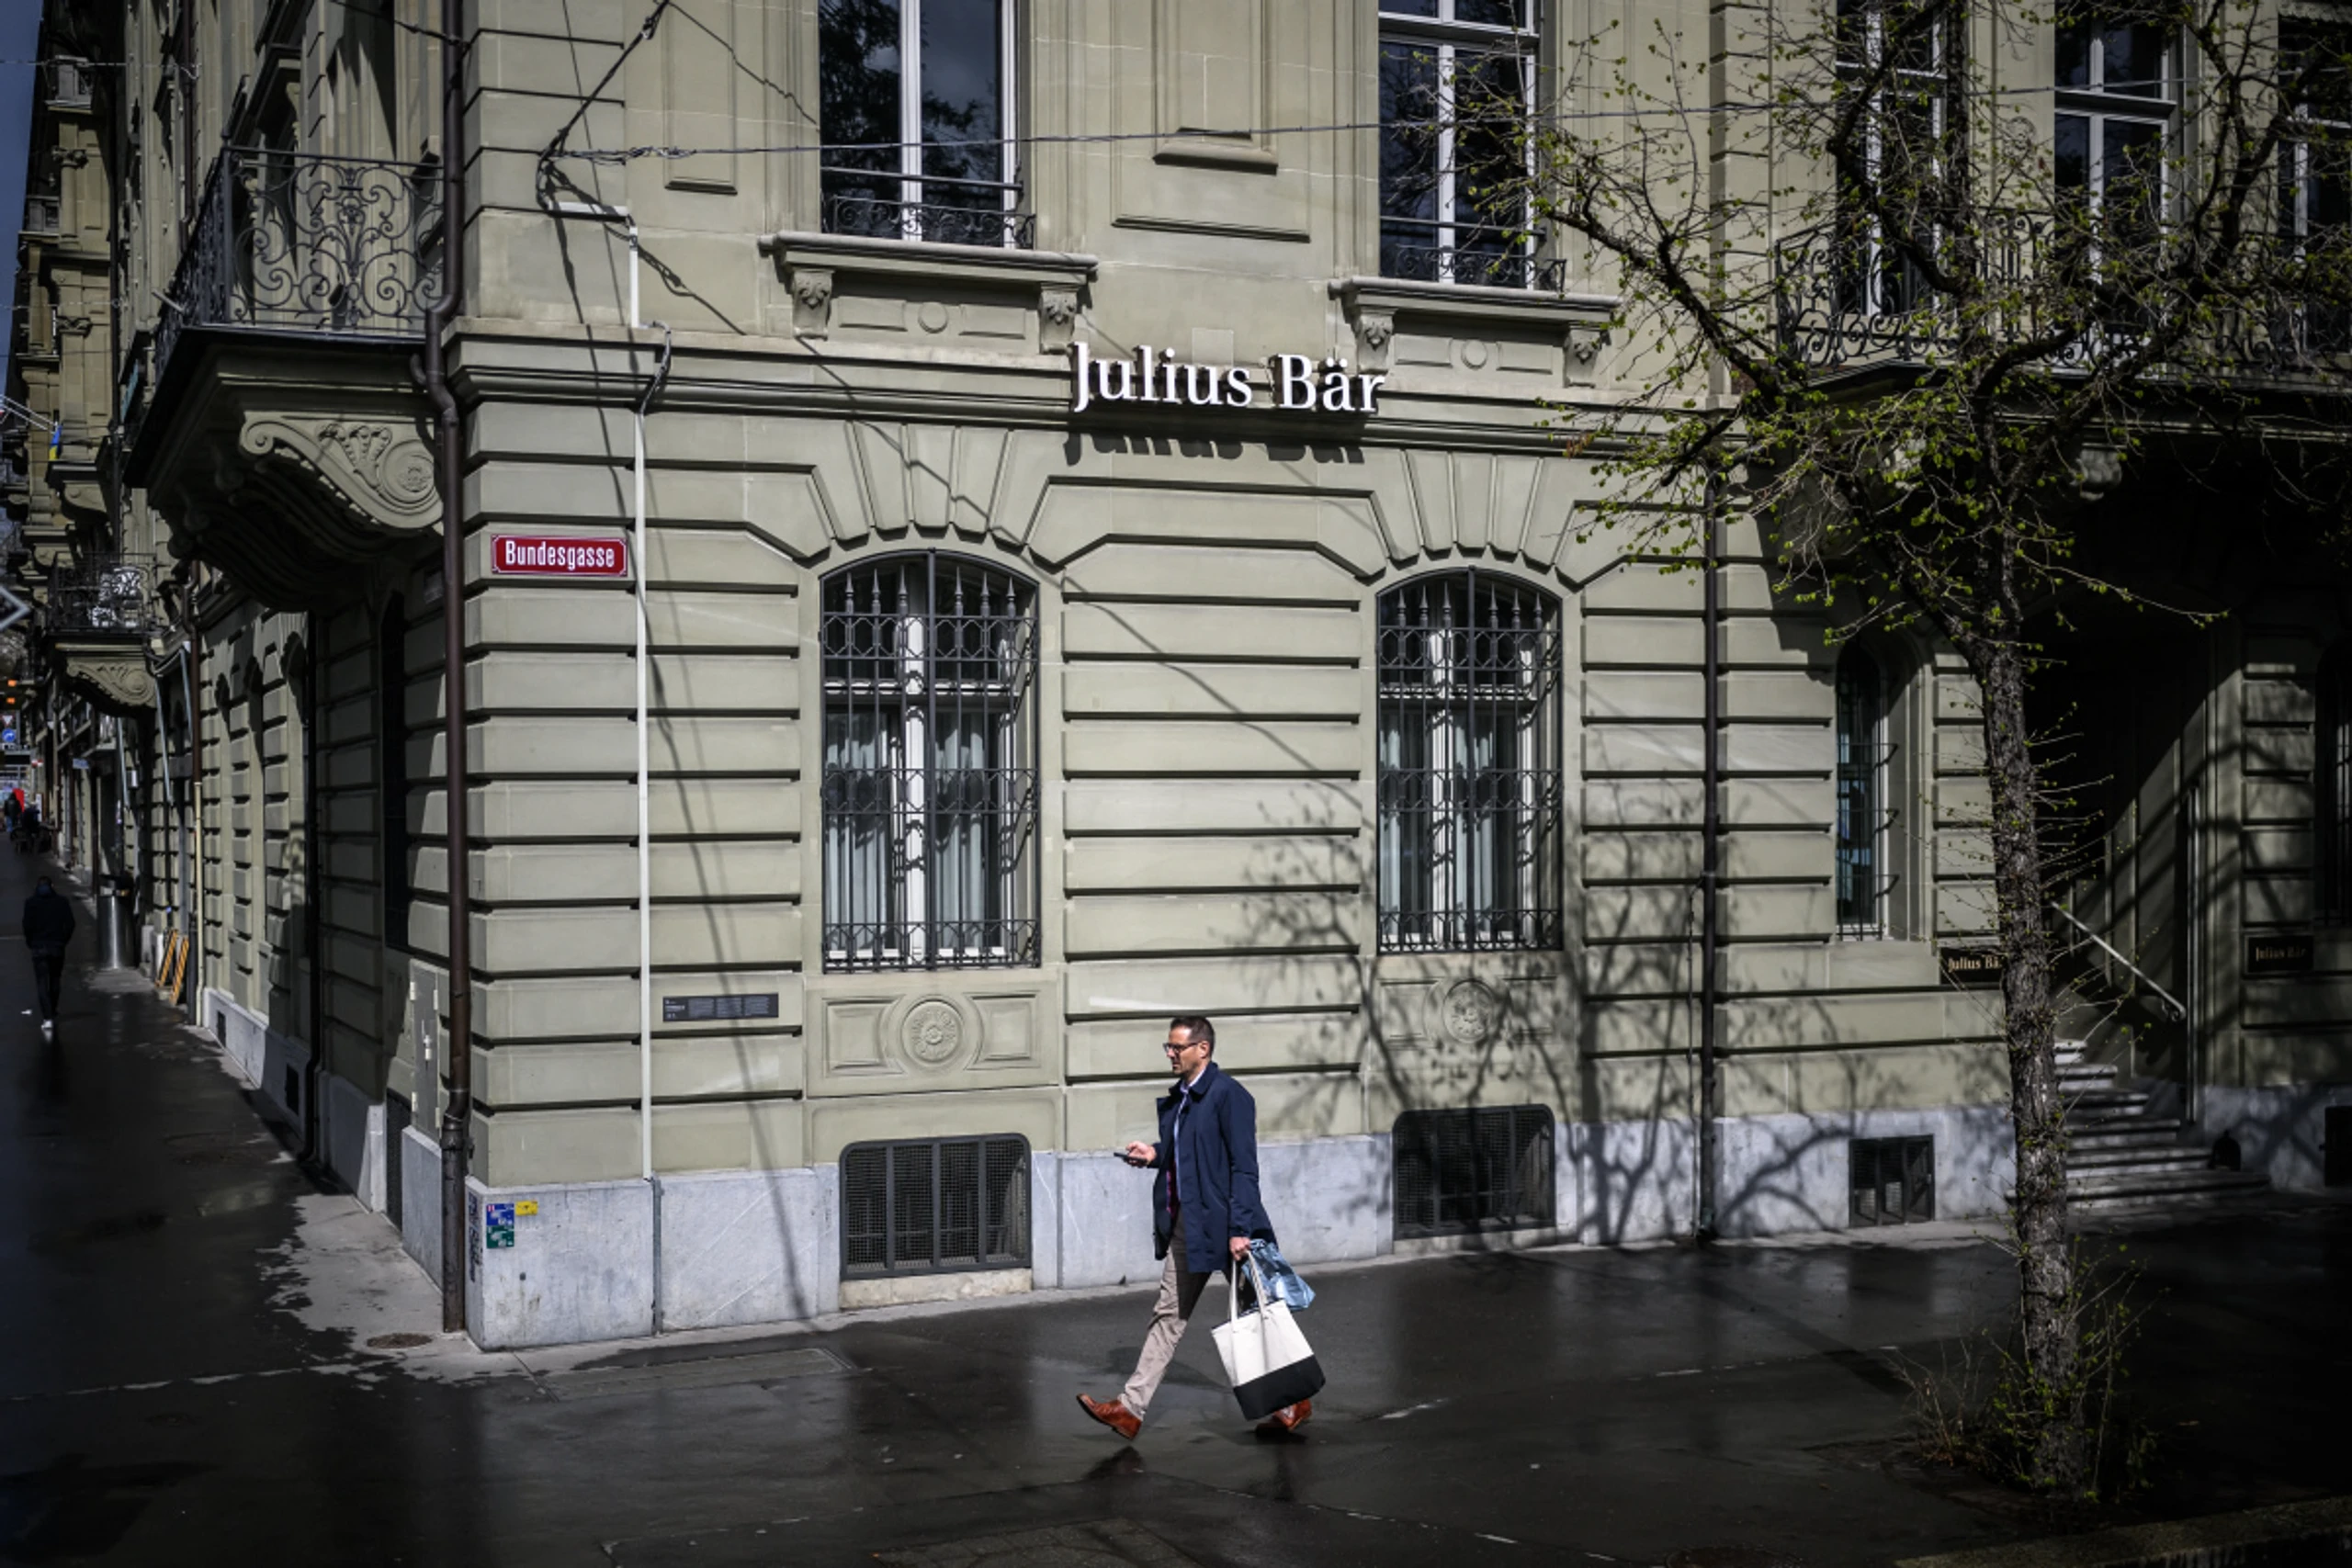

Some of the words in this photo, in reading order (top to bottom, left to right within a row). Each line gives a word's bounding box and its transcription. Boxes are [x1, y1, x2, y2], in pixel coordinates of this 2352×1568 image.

[1071, 341, 1253, 412] Julius
[1276, 354, 1385, 412] Bär
[505, 540, 615, 570] Bundesgasse
